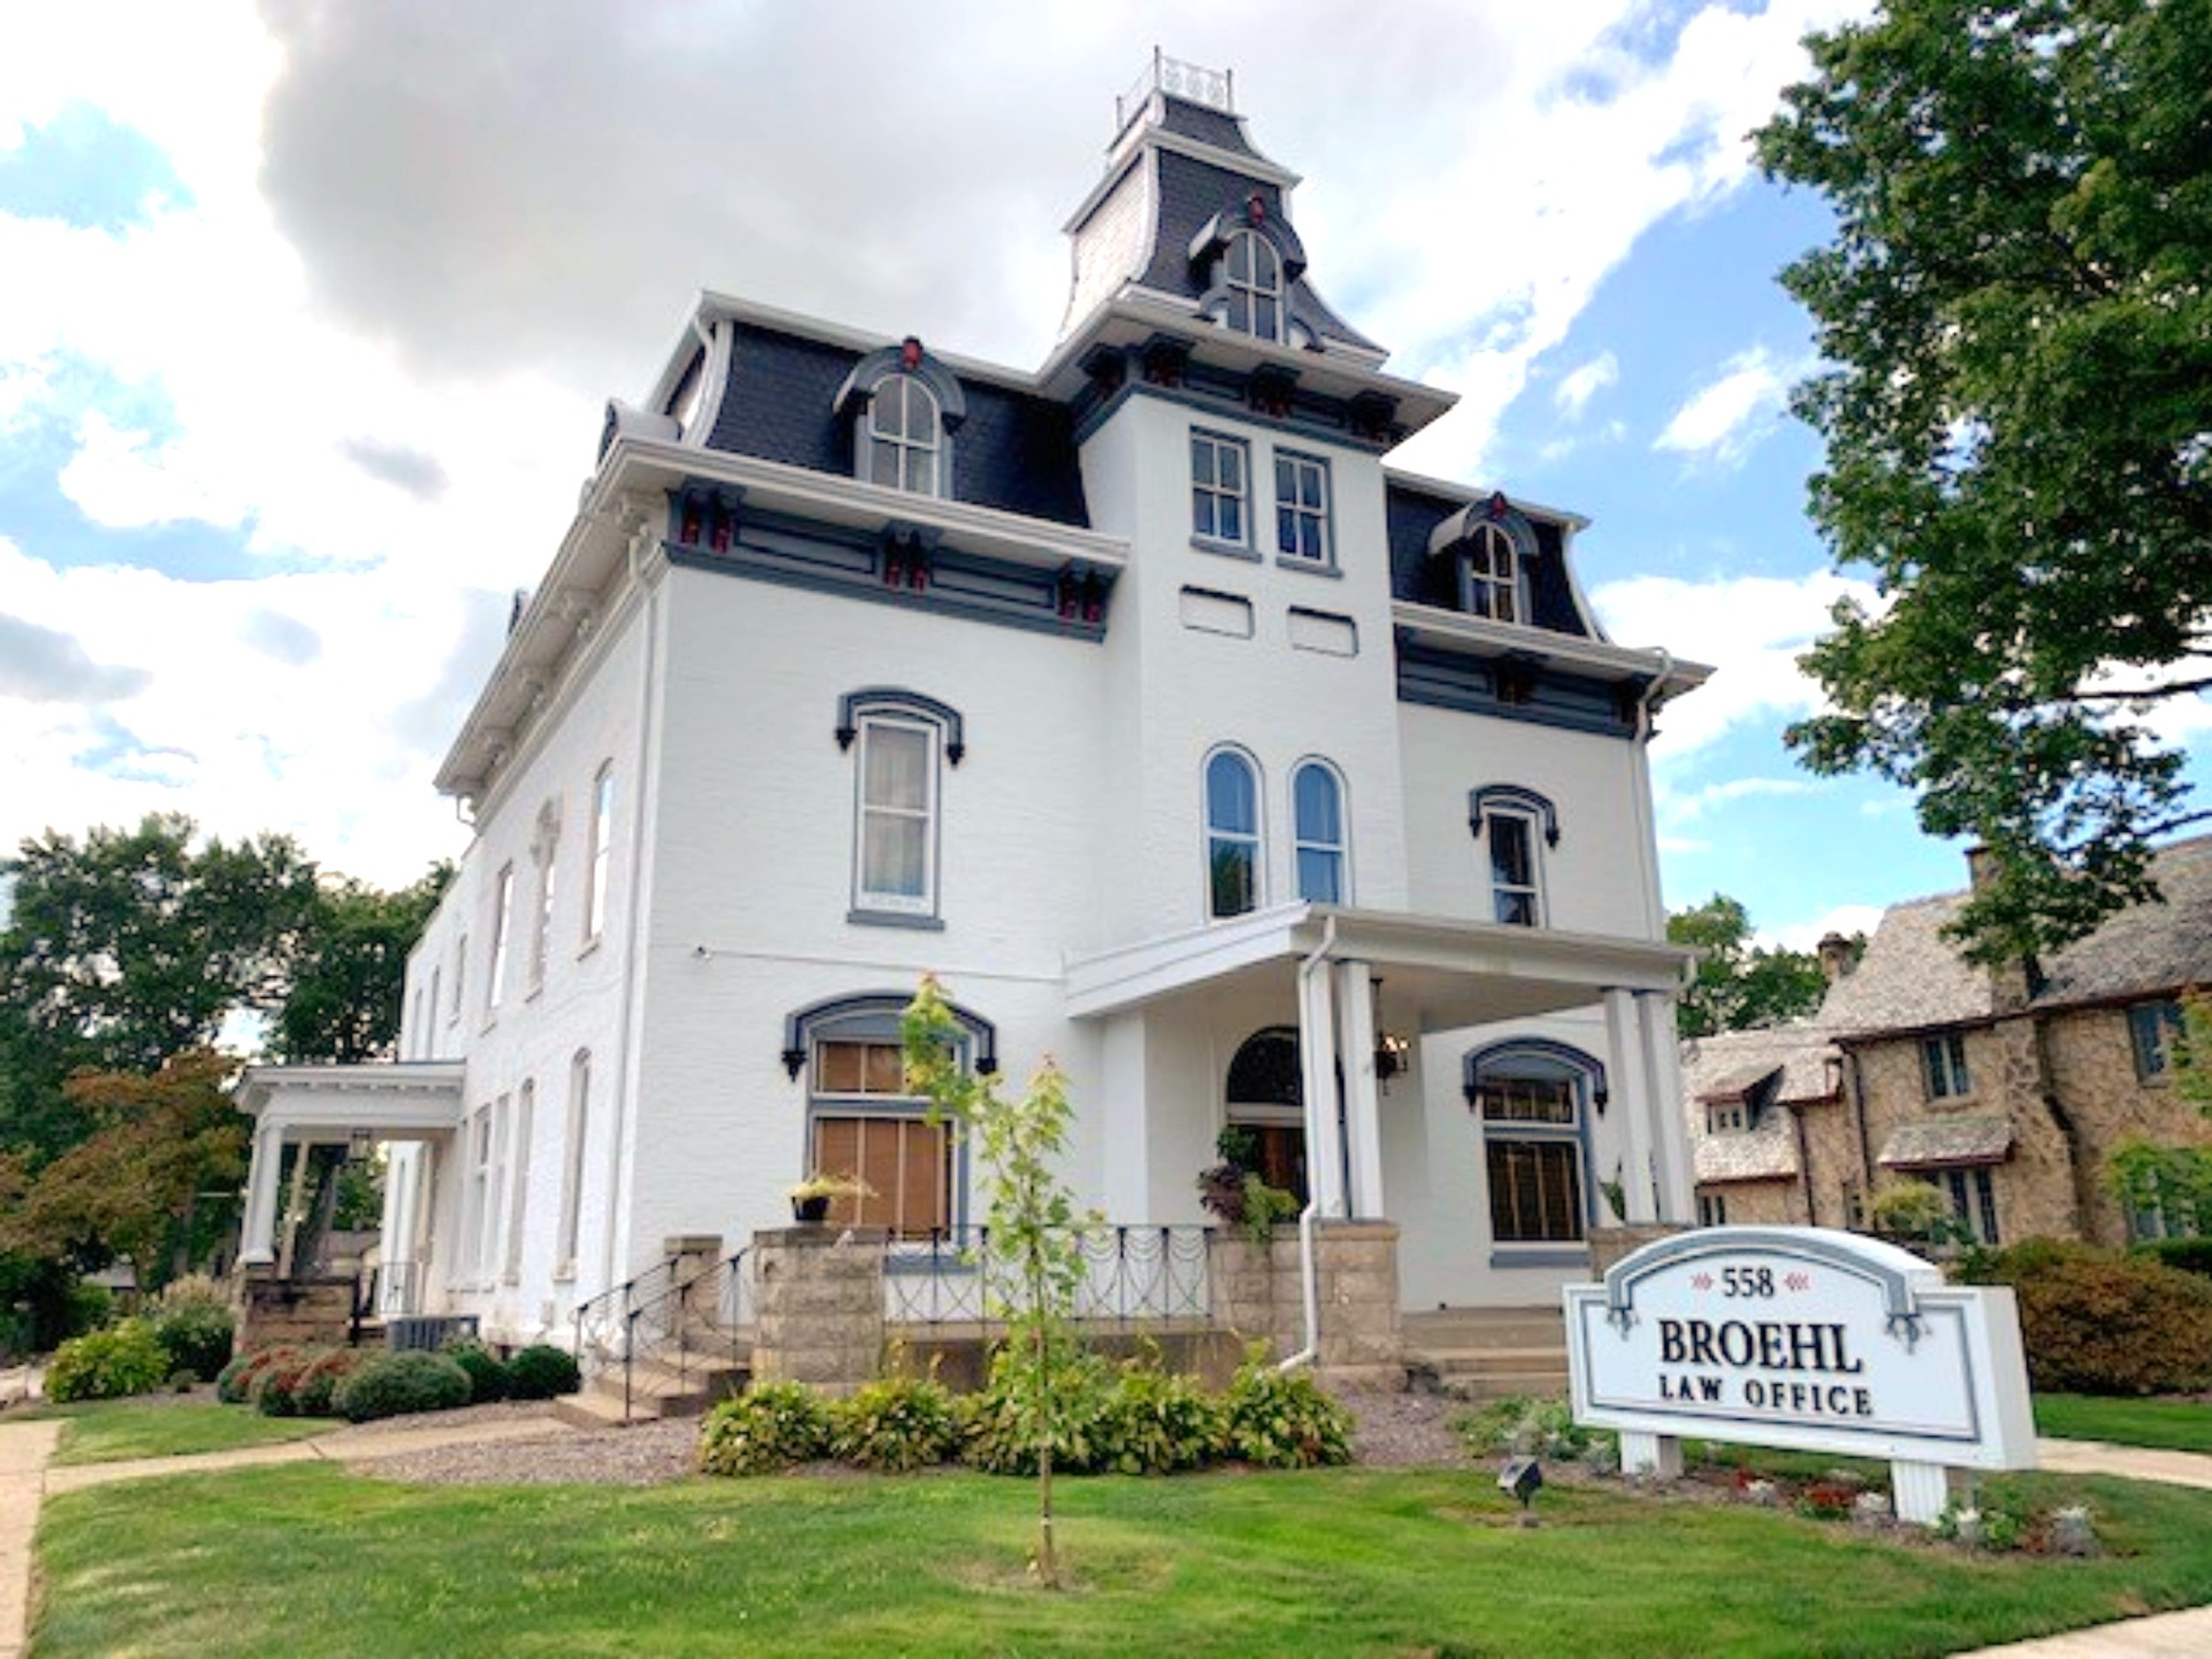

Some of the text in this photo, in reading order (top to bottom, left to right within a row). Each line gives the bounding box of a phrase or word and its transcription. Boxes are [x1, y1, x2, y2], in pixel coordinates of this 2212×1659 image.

[1722, 1267, 1775, 1297] 558
[1658, 1319, 1863, 1373] BROEHL
[1658, 1374, 1874, 1416] LAW OFFICE
